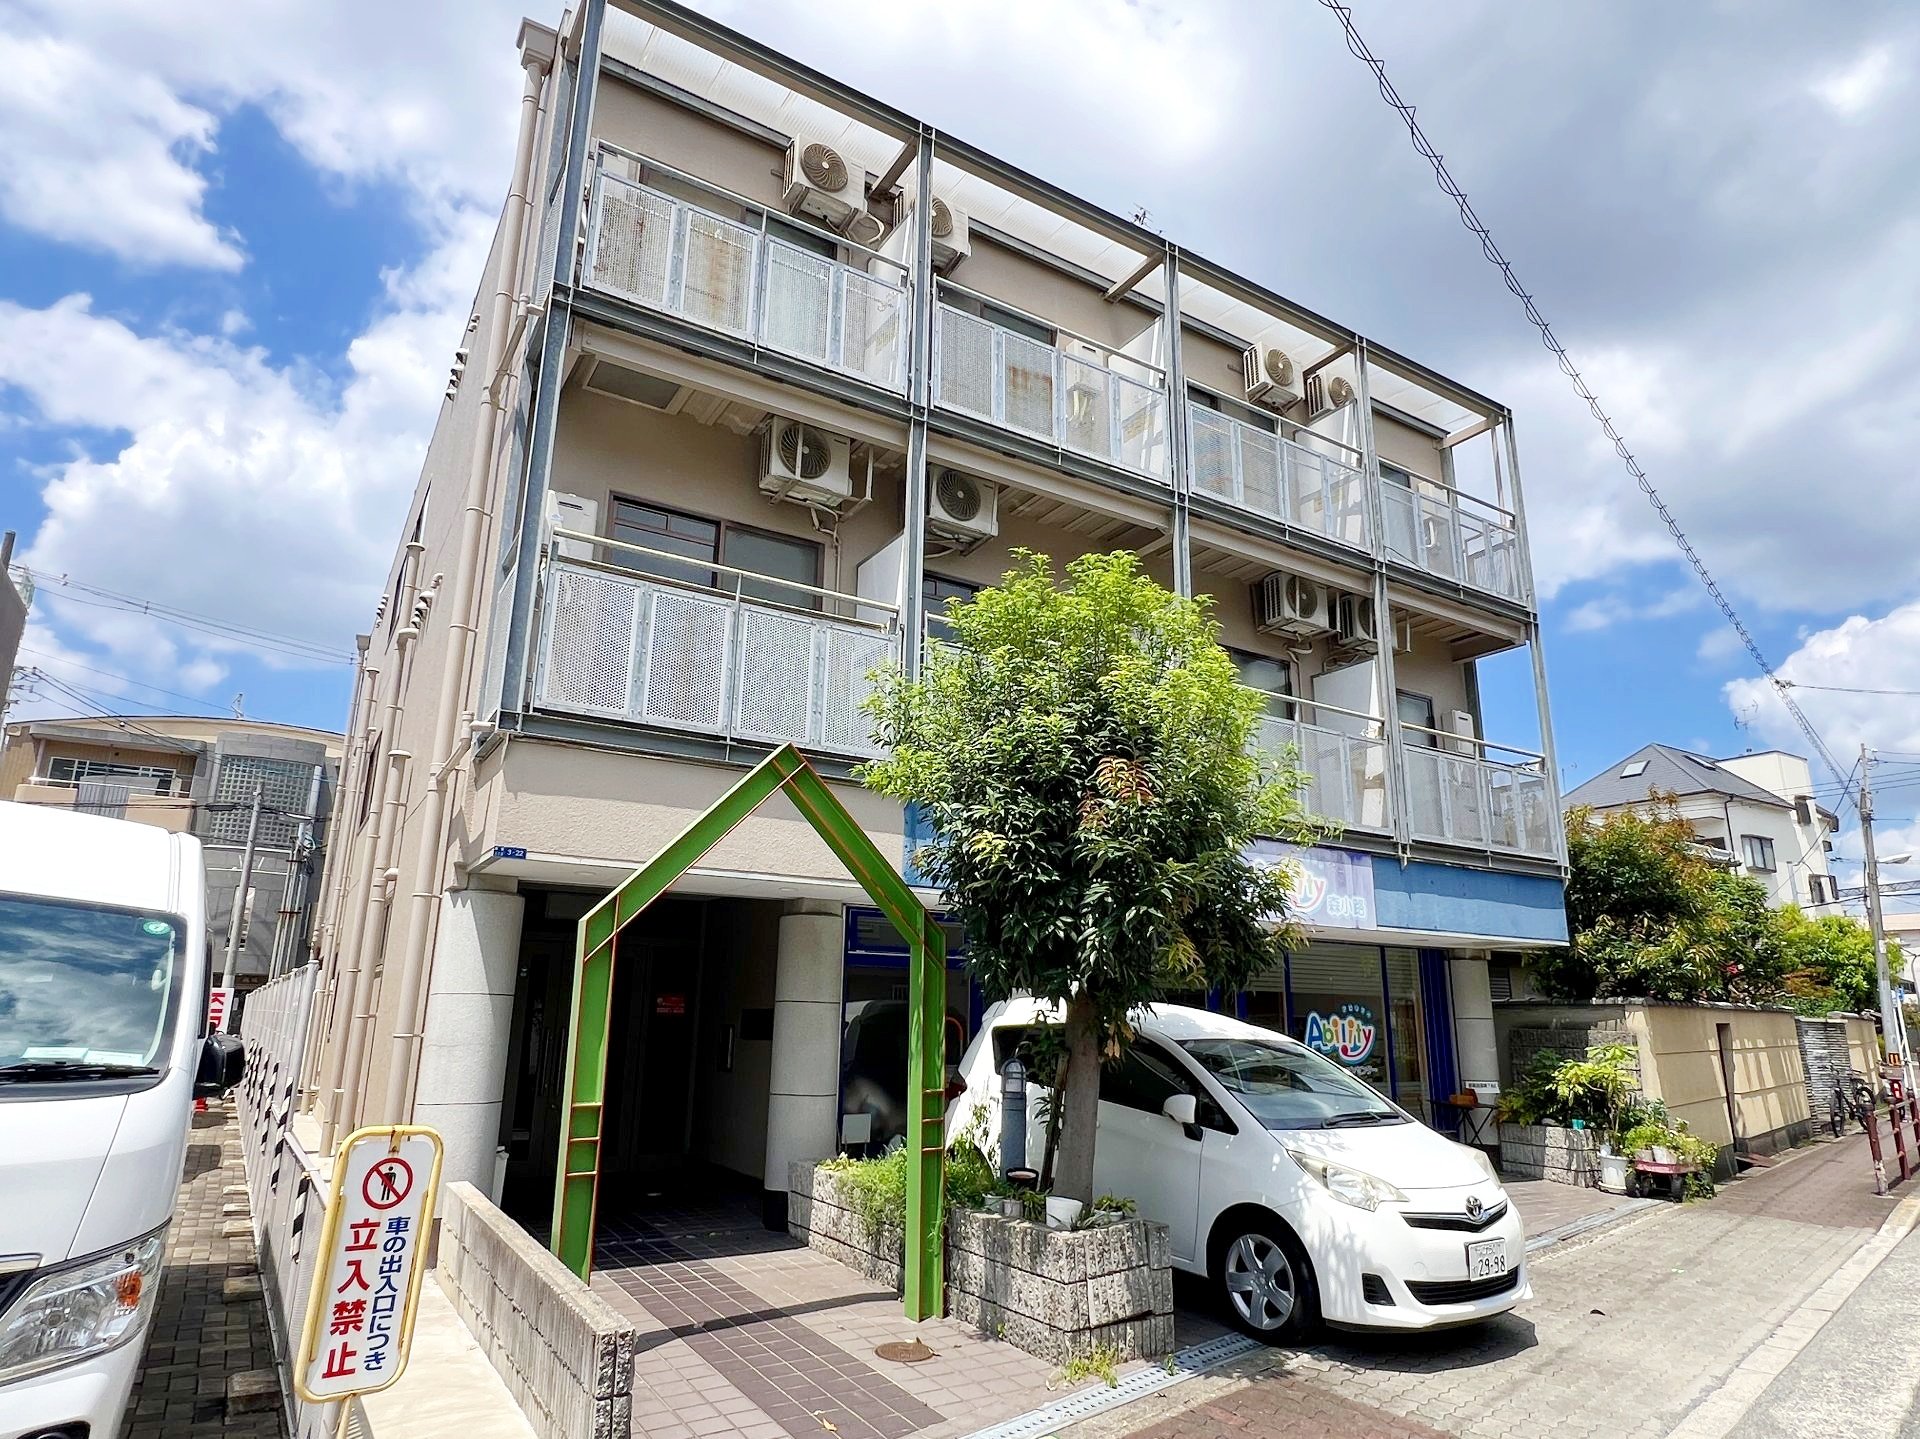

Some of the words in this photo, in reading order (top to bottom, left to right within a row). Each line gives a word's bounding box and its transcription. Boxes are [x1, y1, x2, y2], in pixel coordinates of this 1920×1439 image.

[1307, 1014, 1373, 1058] Ability
[321, 1218, 381, 1380] 立入禁止
[364, 1216, 411, 1371] 車の出入口につき
